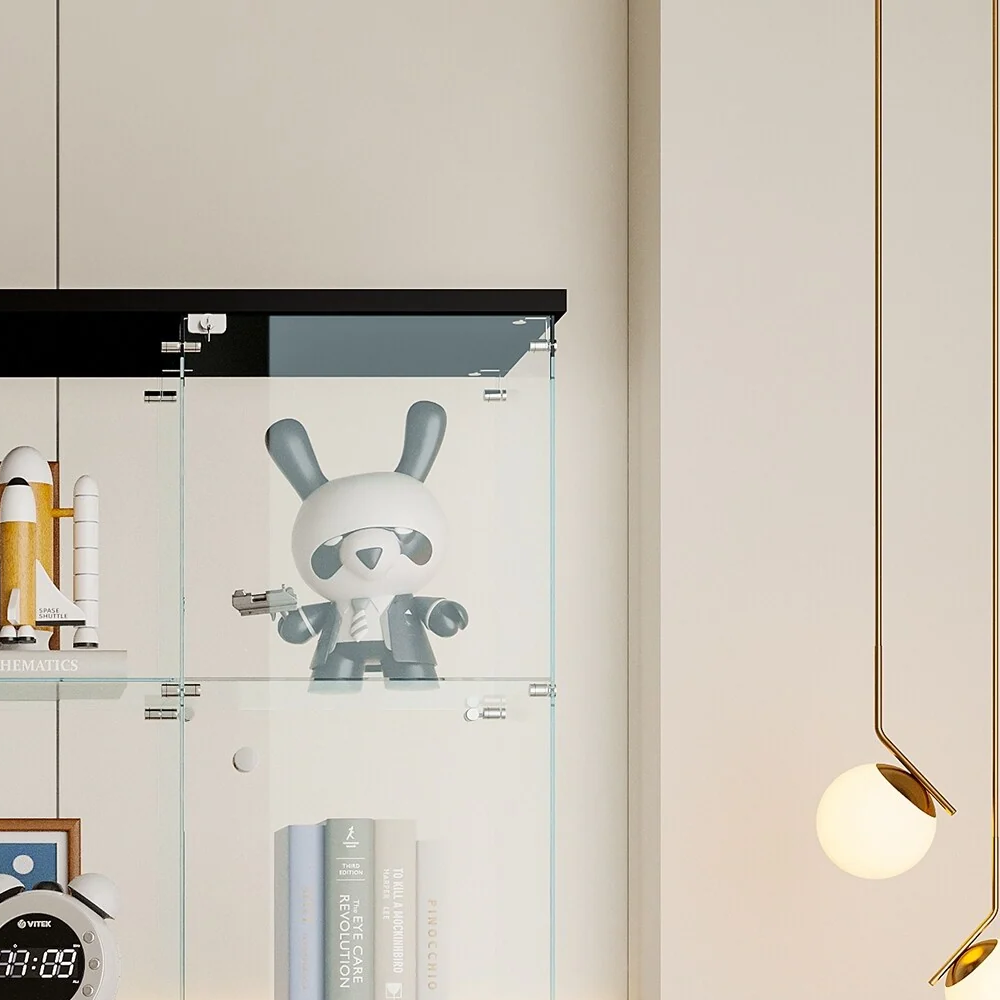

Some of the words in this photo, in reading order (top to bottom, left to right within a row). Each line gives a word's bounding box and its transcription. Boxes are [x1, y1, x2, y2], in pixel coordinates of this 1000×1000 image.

[393, 868, 404, 879] TO
[393, 881, 404, 899] KILL
[393, 902, 404, 910] A
[27, 920, 51, 928] VITEK
[353, 916, 363, 940] EYE
[340, 894, 350, 988] REVOLUTION
[428, 900, 437, 991] PINOCCHIO
[353, 946, 363, 984] CARE
